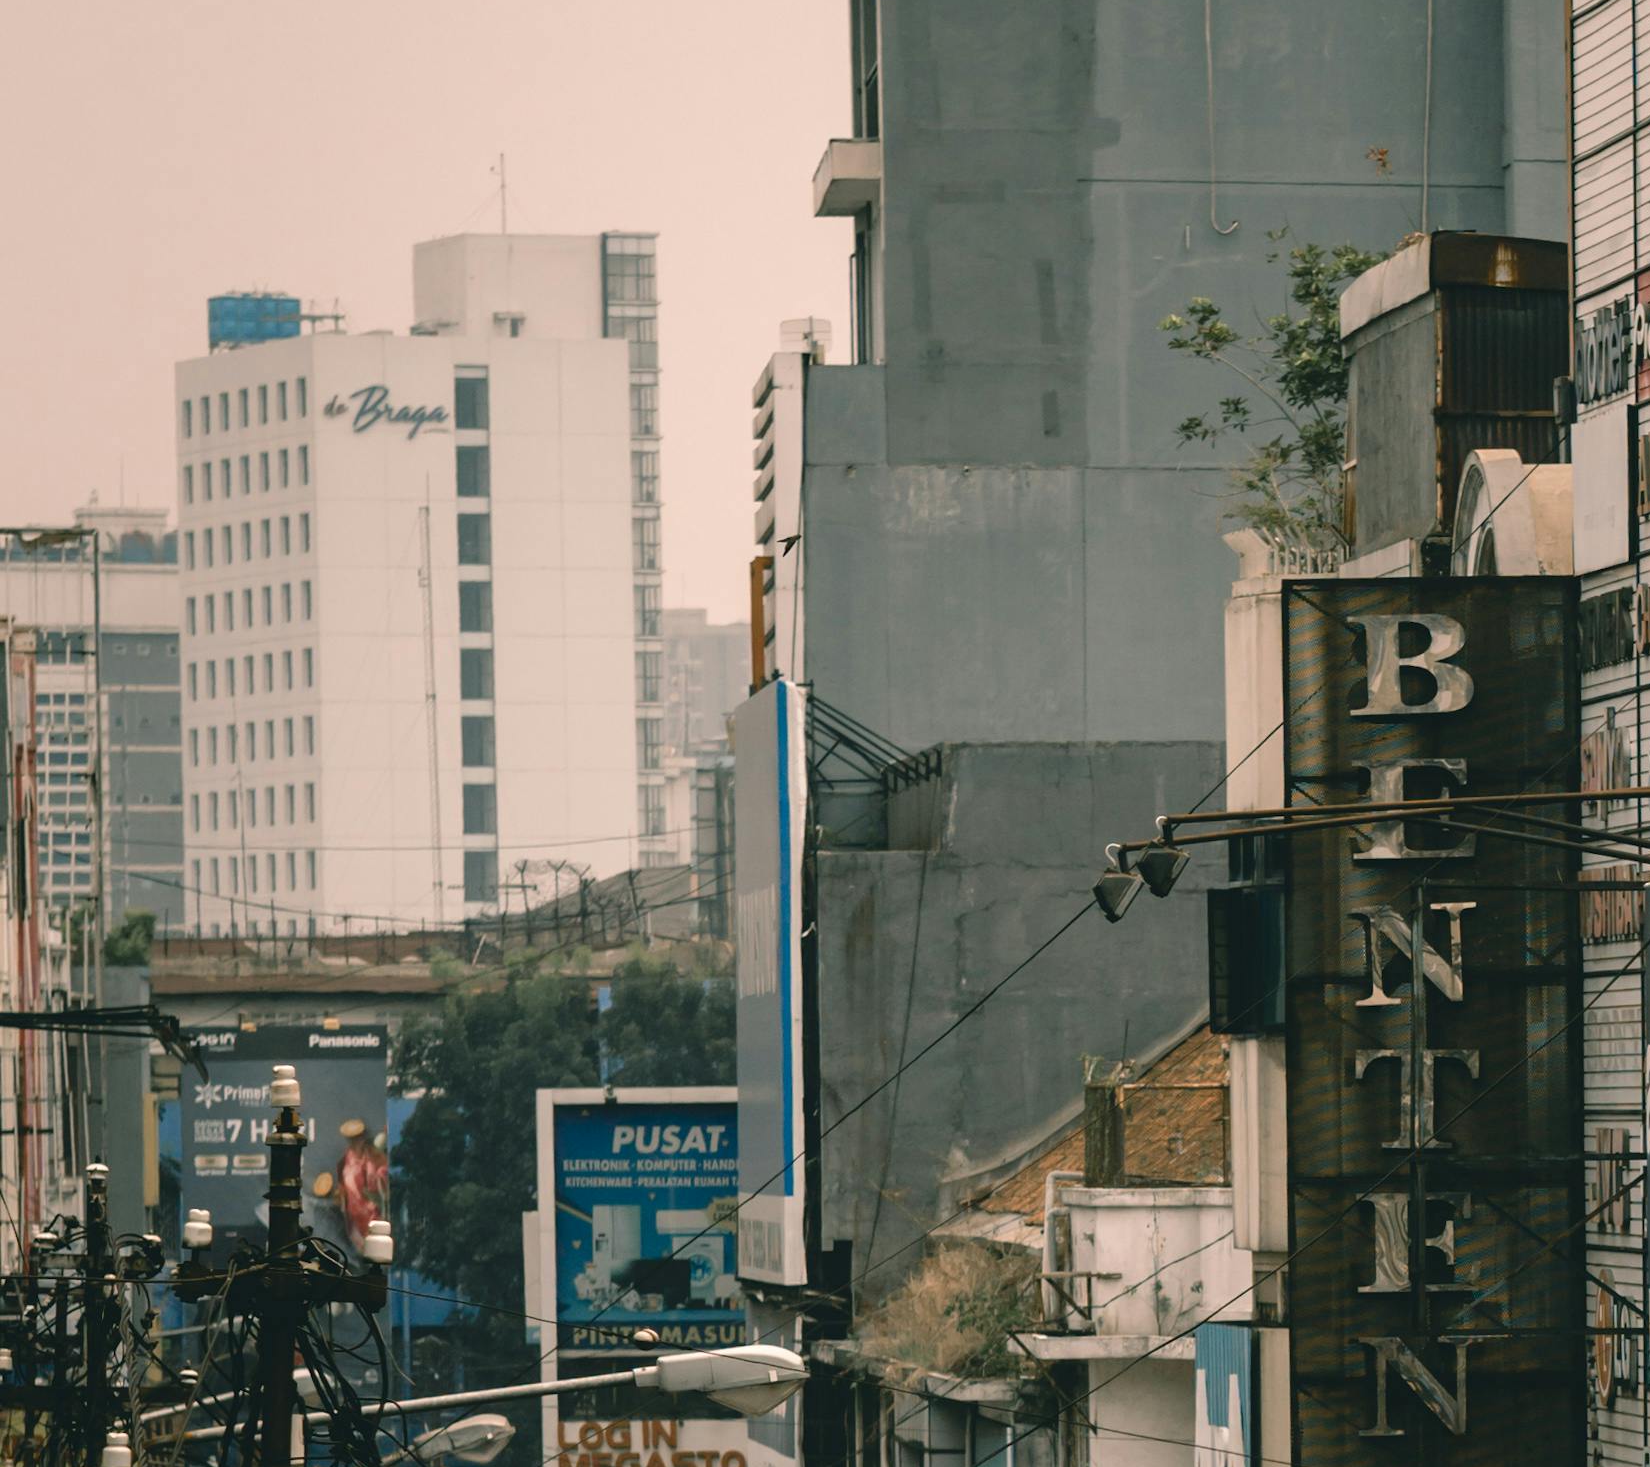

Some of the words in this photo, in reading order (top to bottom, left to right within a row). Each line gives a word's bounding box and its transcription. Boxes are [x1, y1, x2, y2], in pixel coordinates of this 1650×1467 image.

[323, 394, 348, 418] de
[350, 385, 448, 440] Braga
[309, 1035, 380, 1048] Panasonic
[224, 1085, 271, 1101] PrimeF
[226, 1119, 243, 1144] 7
[612, 1125, 726, 1154] PUSAT
[563, 1159, 630, 1171] ELEKTRONIK
[637, 1159, 697, 1171] KOMPUTER
[565, 1176, 633, 1188] KITCHENWARE
[638, 1176, 690, 1187] PERALATAN
[694, 1176, 729, 1187] RUMAH
[574, 1325, 633, 1346] PINT
[557, 1420, 632, 1450] LOG
[643, 1419, 678, 1449] IN
